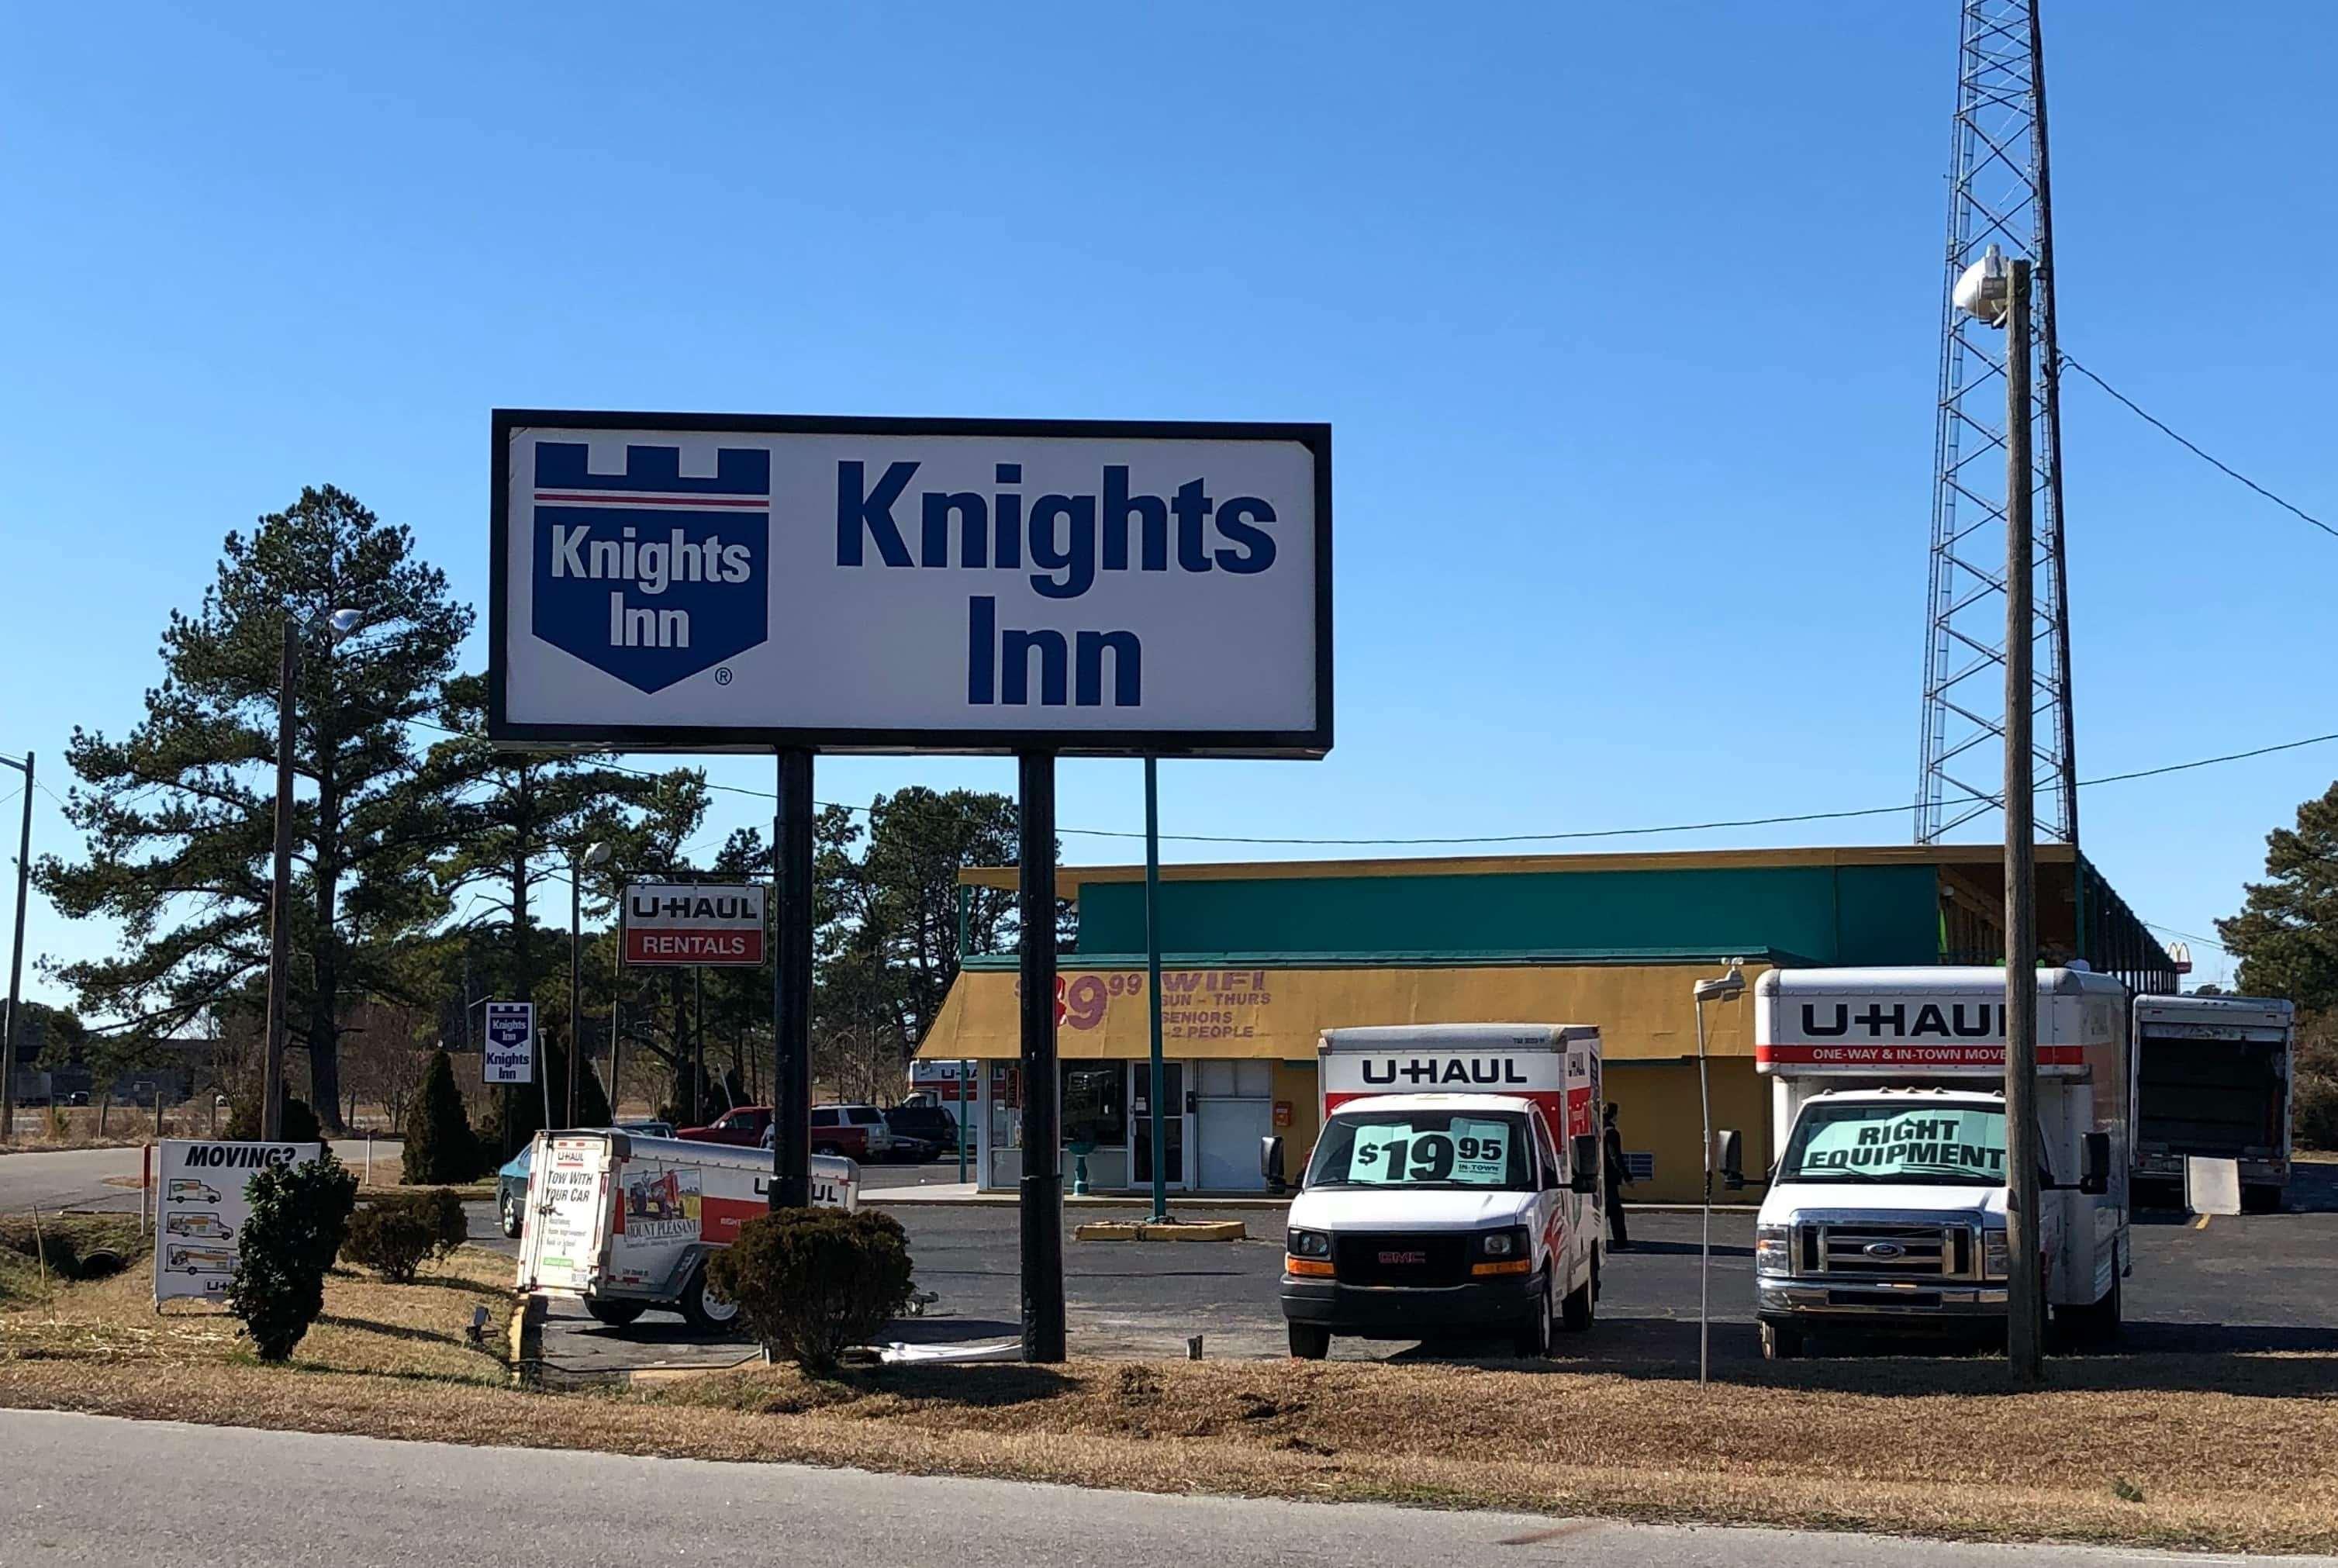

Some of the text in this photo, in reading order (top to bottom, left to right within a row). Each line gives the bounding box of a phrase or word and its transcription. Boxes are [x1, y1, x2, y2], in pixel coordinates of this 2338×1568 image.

[836, 460, 1278, 599] Knights
[550, 524, 751, 596] Knights
[610, 592, 689, 650] Inn
[968, 596, 1142, 708] Inn
[632, 896, 758, 920] U-HAUL
[642, 936, 745, 955] RENTALS
[1161, 994, 1191, 1007] SUN
[1214, 993, 1272, 1007] THURS
[492, 1019, 527, 1031] Knights
[1161, 1010, 1233, 1024] SENIORS
[1802, 1003, 2006, 1038] U-HAU
[502, 1031, 516, 1041] Inn
[1186, 1025, 1254, 1038] PEOPLE
[487, 1052, 530, 1068] Knights
[1812, 1048, 2006, 1060] ONE-WAY & IN-TOWN MOVE
[499, 1067, 516, 1080] Inn
[1362, 1059, 1528, 1085] U-HAUL
[1857, 1118, 1960, 1146] RIGHT
[185, 1145, 296, 1168] MOVING?
[558, 1152, 584, 1162] U-HAUL
[1457, 1137, 1503, 1161] 95
[1808, 1142, 2007, 1170] EQUIPMENT
[548, 1171, 594, 1186] TOW WITH
[546, 1187, 590, 1202] YOUR CAR
[658, 1218, 698, 1237] PLEASANT
[1378, 1252, 1426, 1264] GMC
